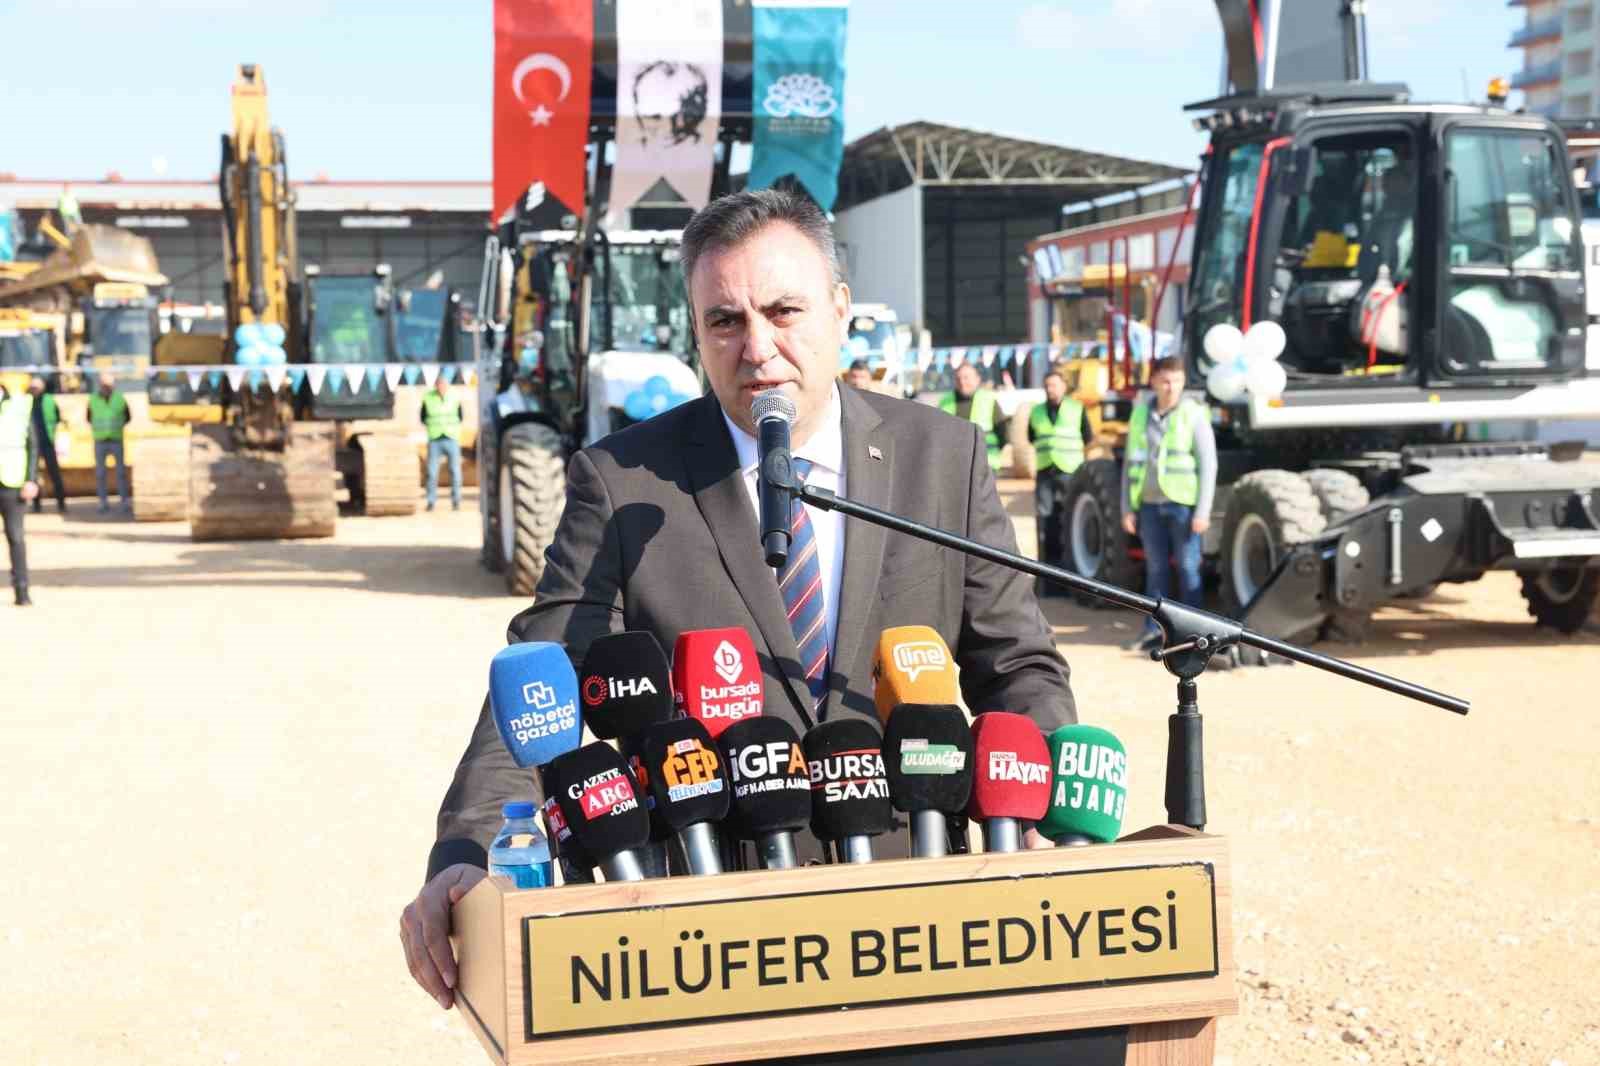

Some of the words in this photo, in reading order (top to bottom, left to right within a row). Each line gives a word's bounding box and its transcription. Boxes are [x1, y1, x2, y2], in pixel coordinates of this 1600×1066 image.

[701, 681, 760, 700] bursada
[510, 700, 576, 731] nöbetçi
[701, 697, 761, 720] bugün
[516, 716, 575, 745] gazete
[663, 746, 719, 787] CEP
[808, 754, 886, 783] BURSA
[989, 760, 1050, 785] HAYAT
[1058, 742, 1127, 789] BURS
[568, 767, 622, 800] GAZETE
[589, 782, 630, 813] ABC
[610, 798, 639, 816] .COM
[1054, 781, 1125, 820] AJANS
[571, 929, 830, 1004] NİLÜFER
[851, 890, 1178, 978] BELEDİYESİ
